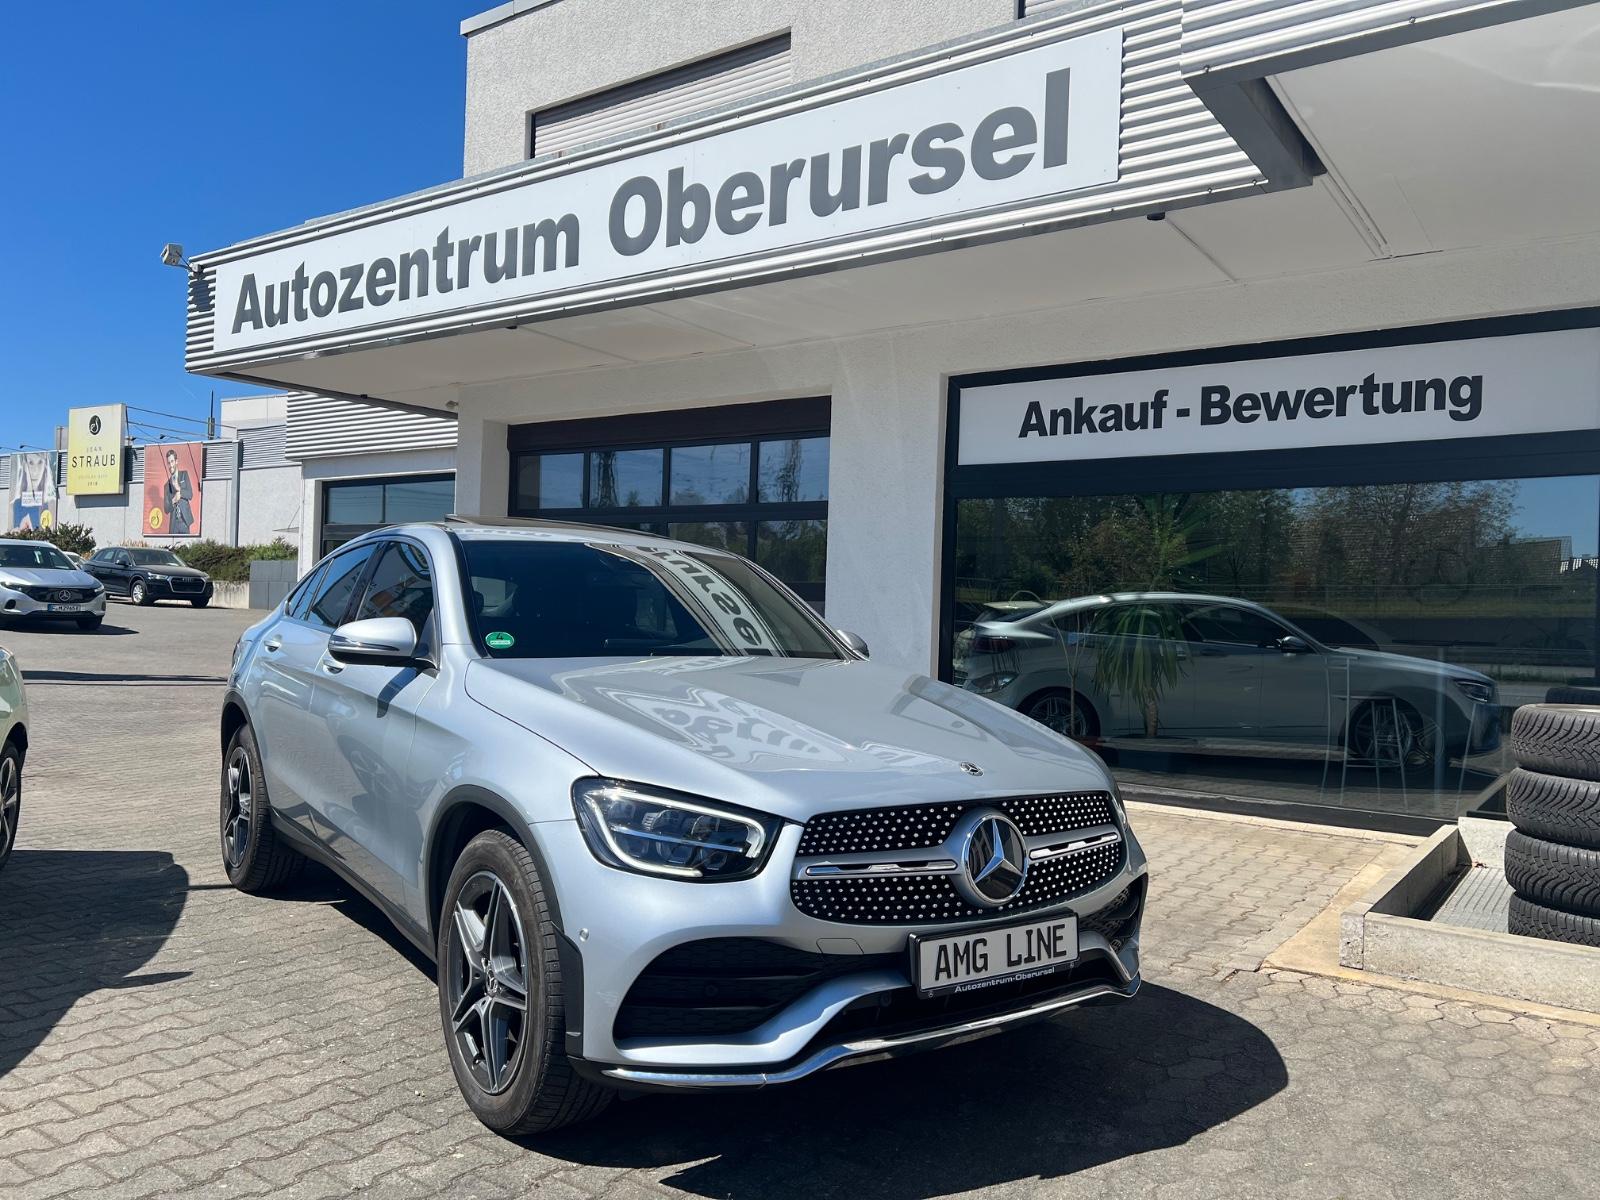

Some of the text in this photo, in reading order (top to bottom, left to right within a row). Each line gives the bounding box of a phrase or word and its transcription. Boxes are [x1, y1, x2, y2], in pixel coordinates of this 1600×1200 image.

[231, 67, 1071, 334] Autozentrum Oberursel
[1018, 389, 1168, 438] Ankauf
[1200, 372, 1484, 425] Bewertung
[71, 453, 116, 468] STRAUB
[934, 923, 1067, 982] AMG LINE
[954, 966, 1056, 993] Autozentrum-Oberursel
